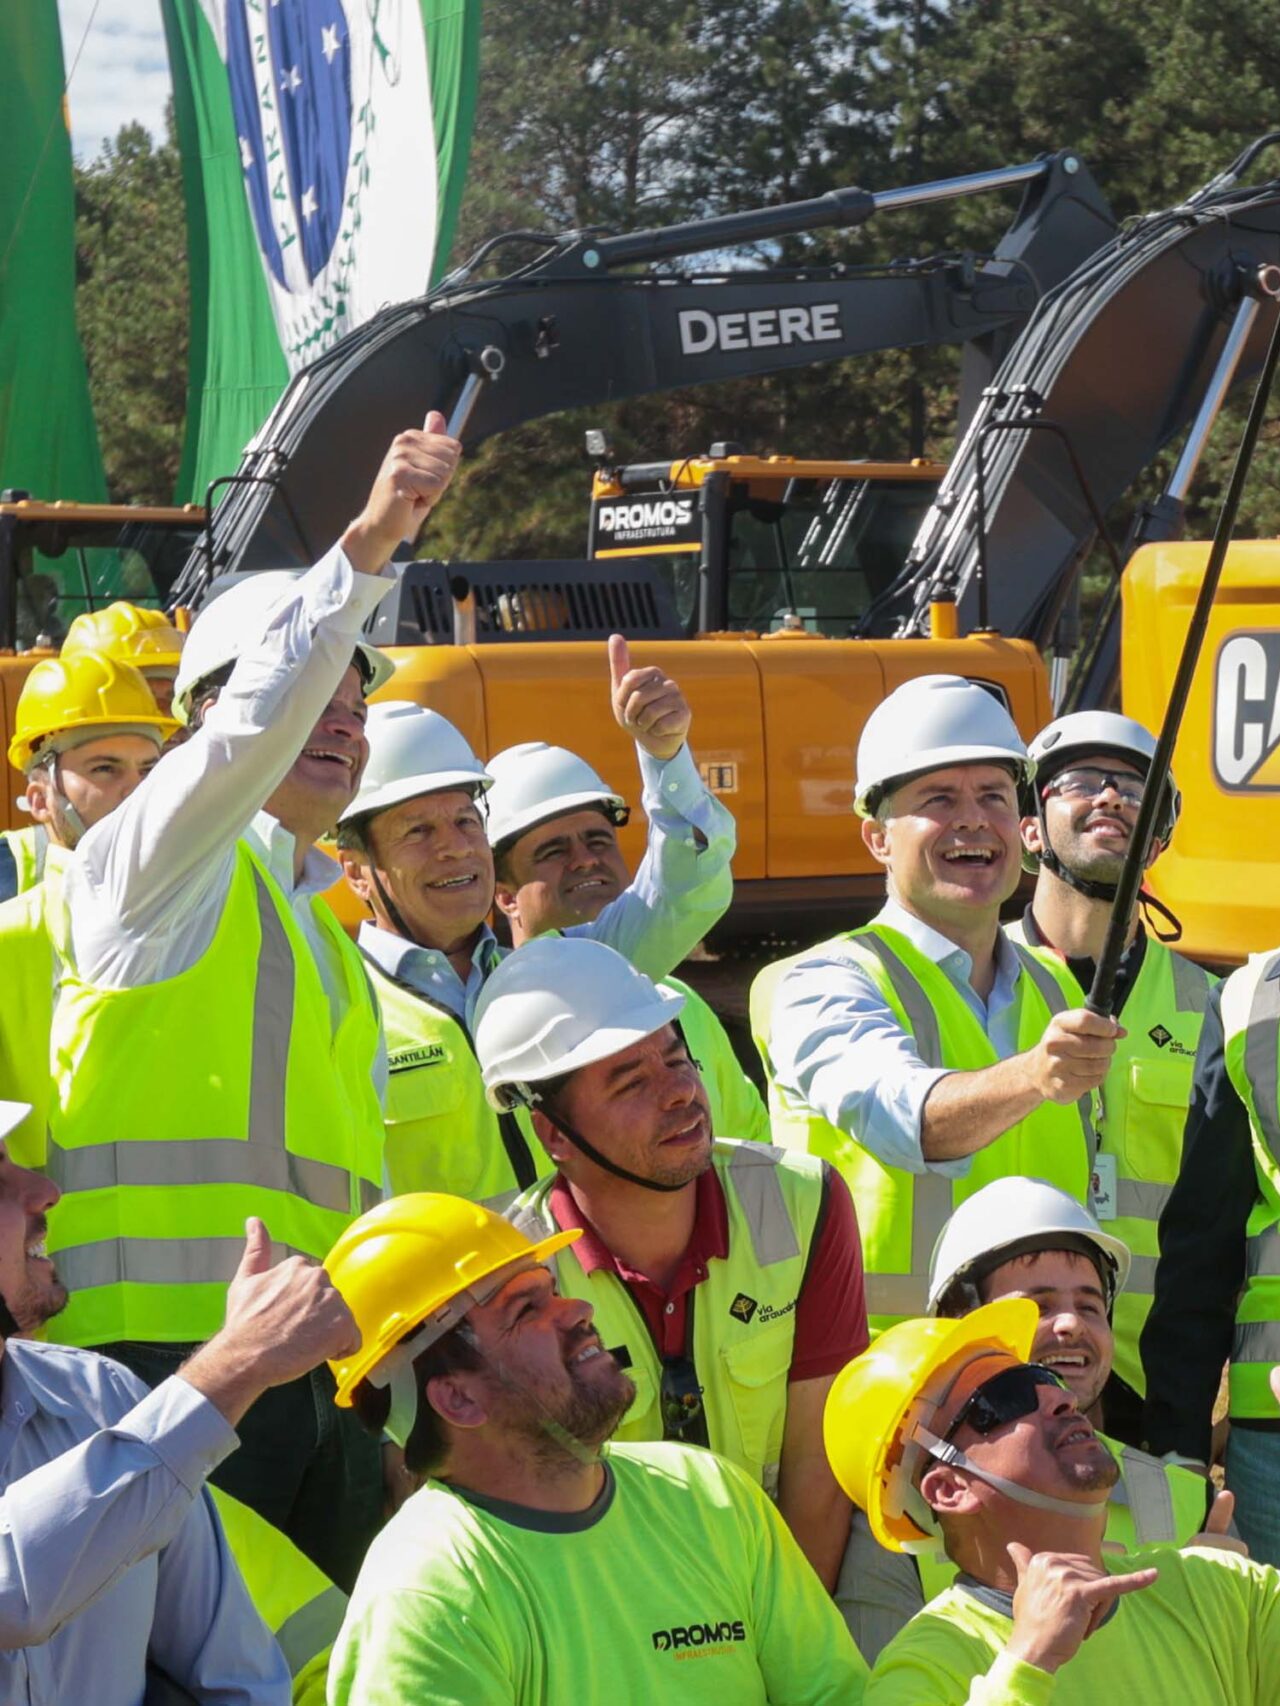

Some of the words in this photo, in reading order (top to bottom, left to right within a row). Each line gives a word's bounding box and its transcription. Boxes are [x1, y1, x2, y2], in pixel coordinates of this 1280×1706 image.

[679, 304, 842, 354] DEERE
[599, 500, 692, 531] DROMOS
[614, 526, 676, 540] INFRAESTRUTURA
[388, 1045, 443, 1066] SANTILLÁN
[652, 1621, 745, 1652] DROMOS
